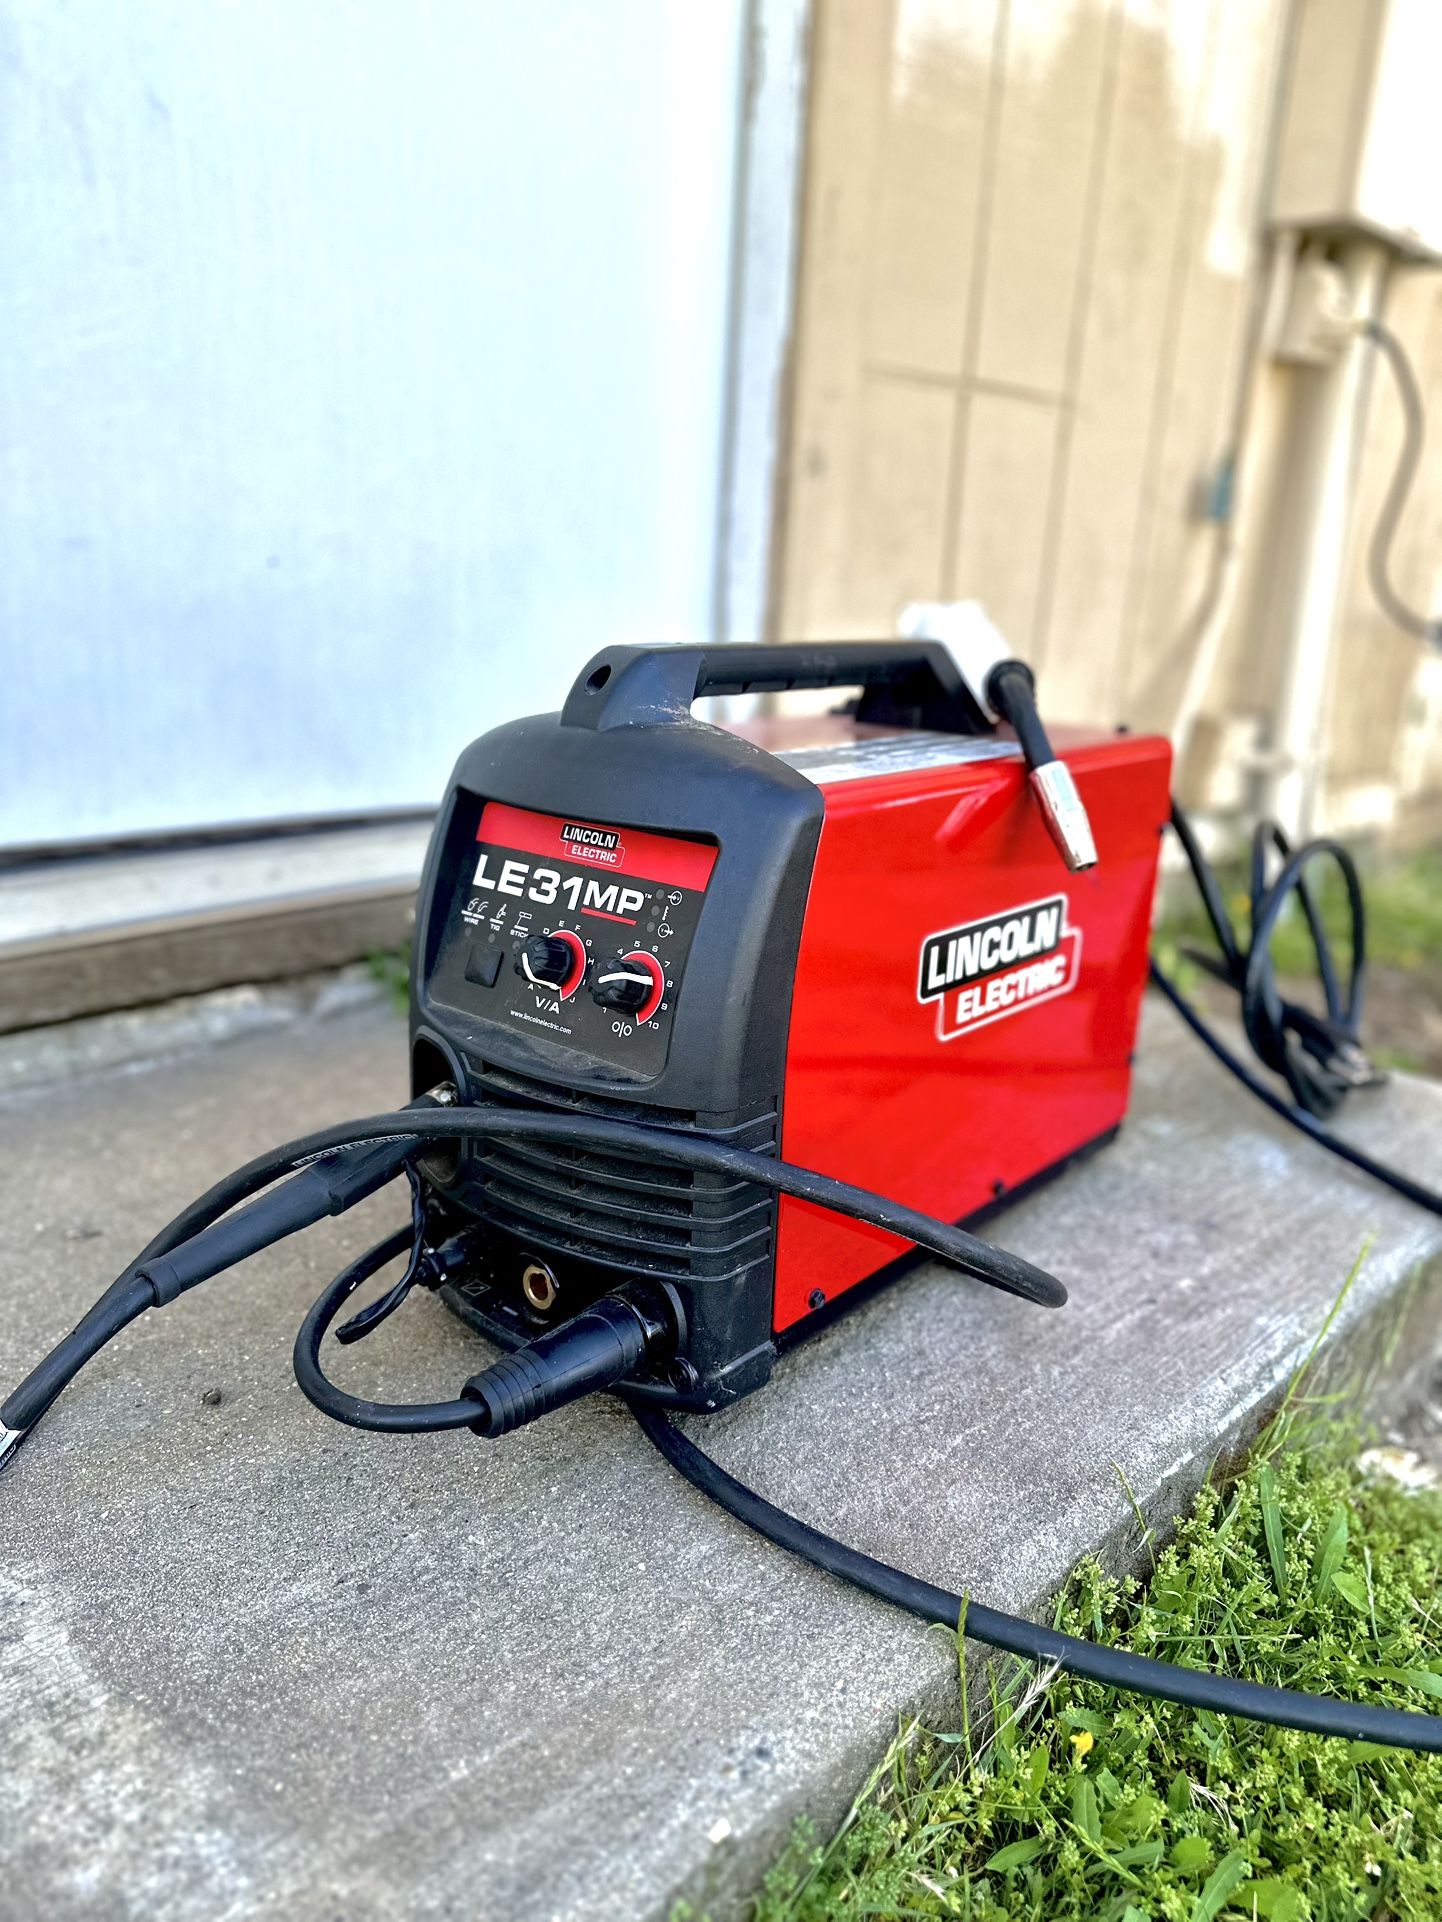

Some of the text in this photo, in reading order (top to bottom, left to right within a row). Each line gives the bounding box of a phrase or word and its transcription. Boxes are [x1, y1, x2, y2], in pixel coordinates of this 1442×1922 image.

[562, 826, 616, 849] LINCOLN
[571, 845, 618, 863] ELECTRIC
[472, 854, 645, 915] LE31MP
[464, 916, 479, 926] WIRE
[558, 920, 565, 928] E
[490, 923, 501, 932] TIG
[543, 927, 550, 935] D
[574, 924, 581, 932] F
[585, 939, 593, 947] G
[633, 940, 641, 948] 5
[617, 948, 624, 956] 4
[651, 945, 659, 953] 6
[927, 906, 1060, 990] LINCOLN
[587, 957, 595, 966] H
[664, 960, 671, 968] 7
[666, 980, 674, 988] 8
[955, 954, 1067, 1025] ELECTRIC
[535, 995, 560, 1014] V/A
[660, 1002, 668, 1011] 9
[510, 1009, 572, 1035] www.lincolnelectric.com
[647, 1020, 660, 1030] 10
